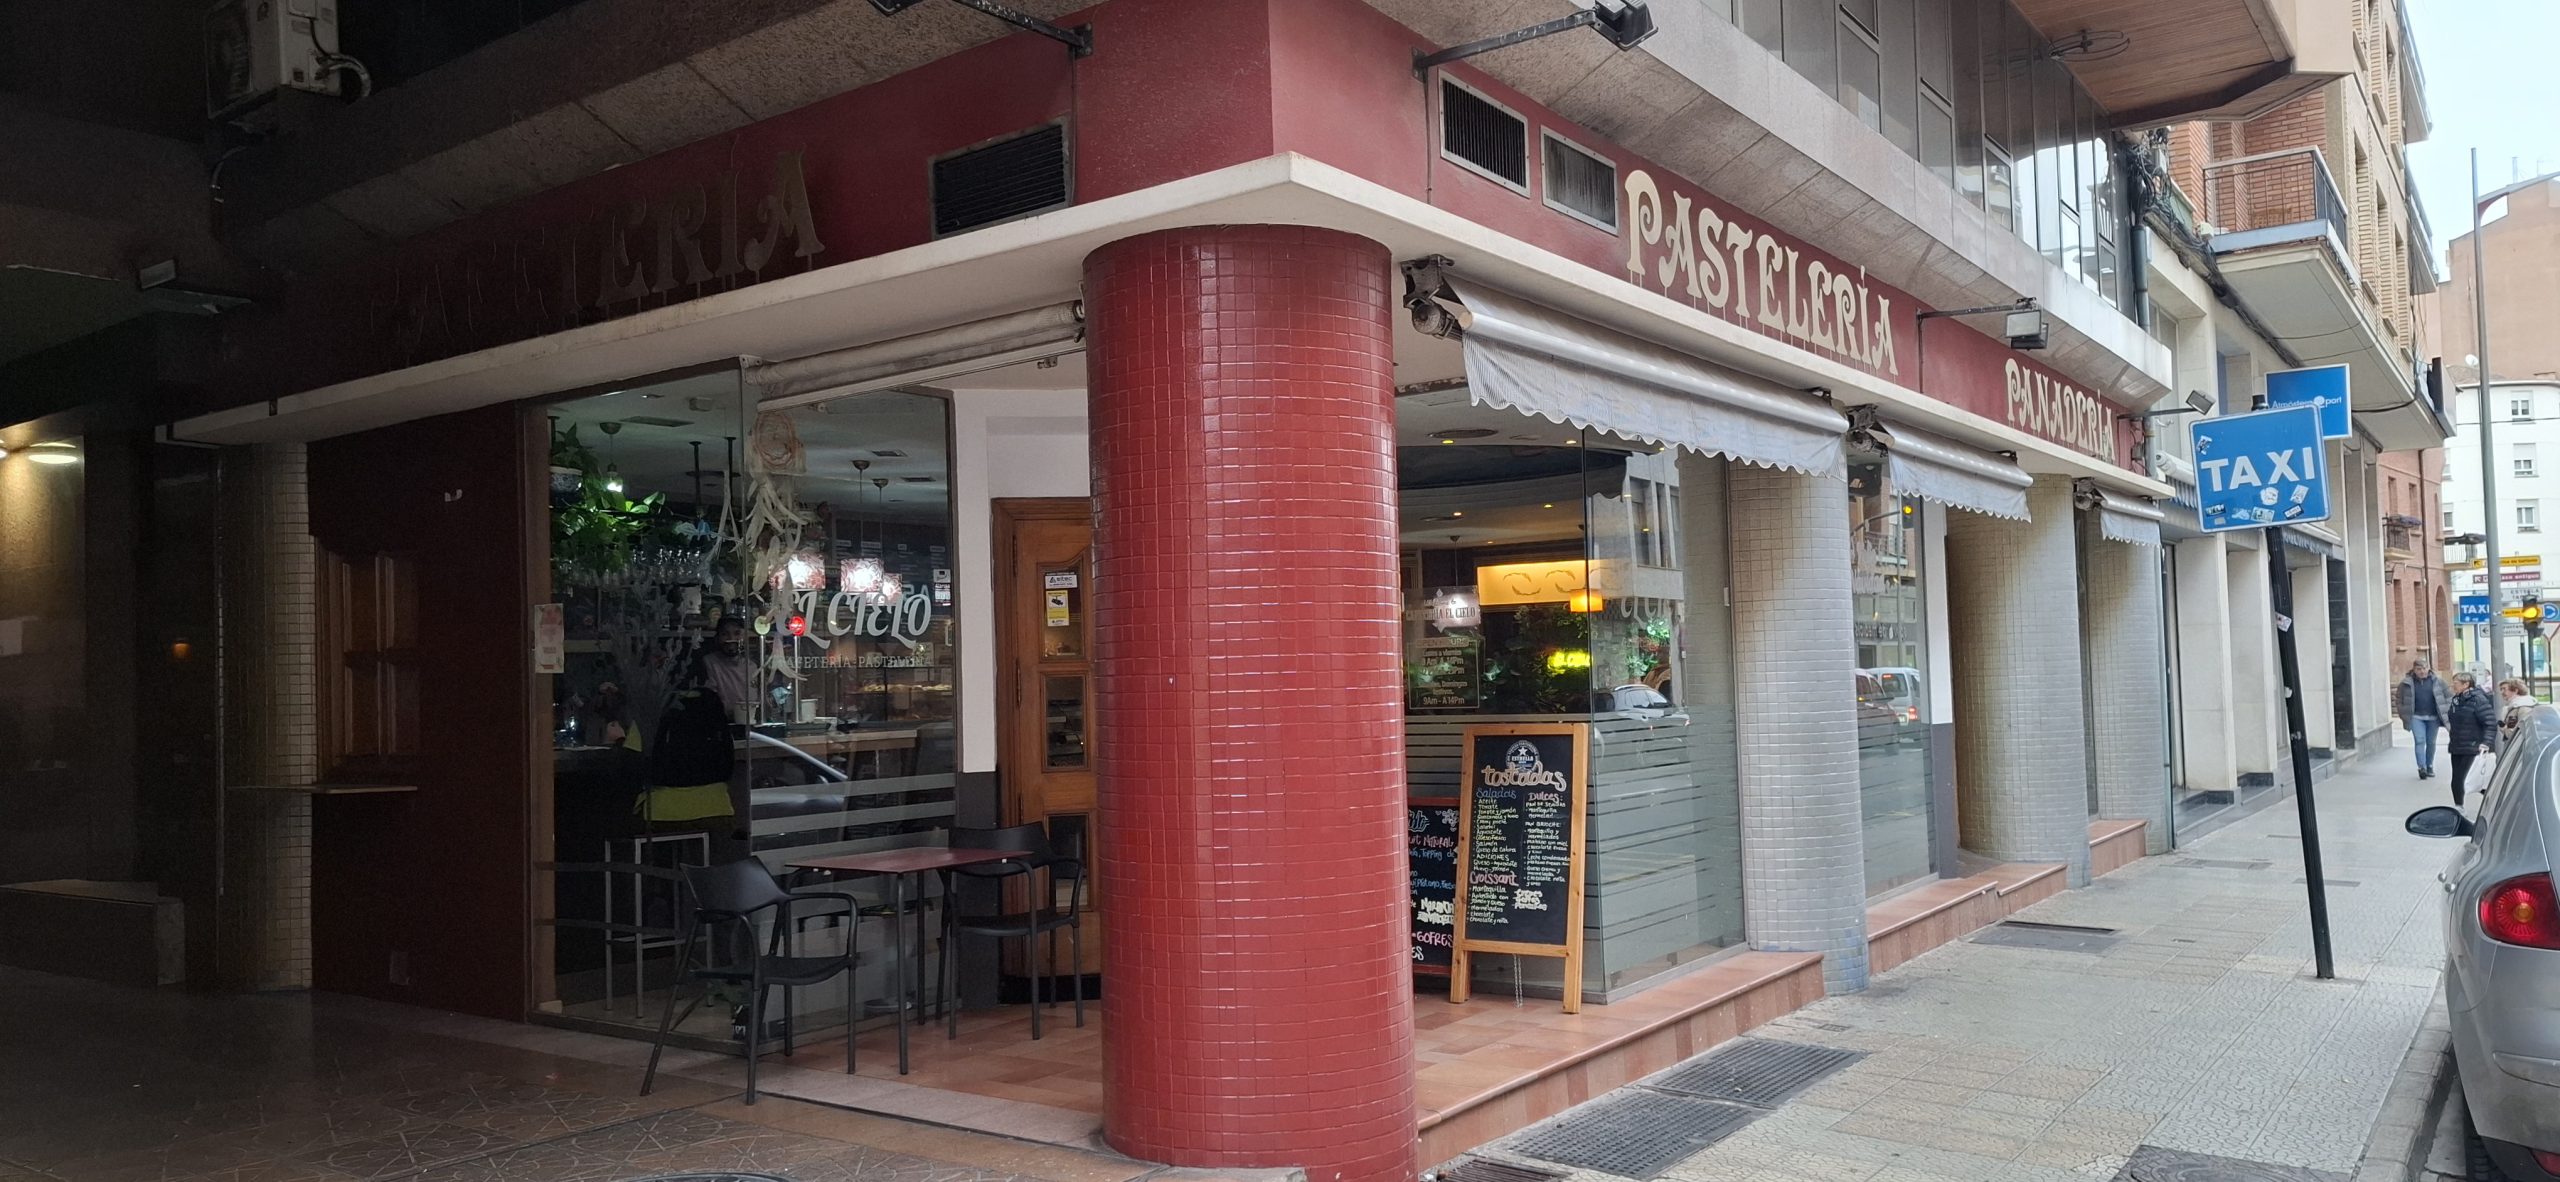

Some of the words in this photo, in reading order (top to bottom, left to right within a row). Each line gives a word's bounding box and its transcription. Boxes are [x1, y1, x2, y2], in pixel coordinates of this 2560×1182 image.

[1623, 168, 1899, 376] PASTELERÍA
[2005, 358, 2116, 461] PANADERÍA
[2200, 447, 2316, 492] TAXI
[827, 591, 932, 650] CIELO
[1445, 608, 1454, 619] EL
[1455, 607, 1477, 618] CIELO
[2460, 604, 2490, 614] TAXI
[1481, 760, 1567, 792] tostadas
[1476, 787, 1517, 799] Saladas
[1469, 871, 1519, 887] Croissant
